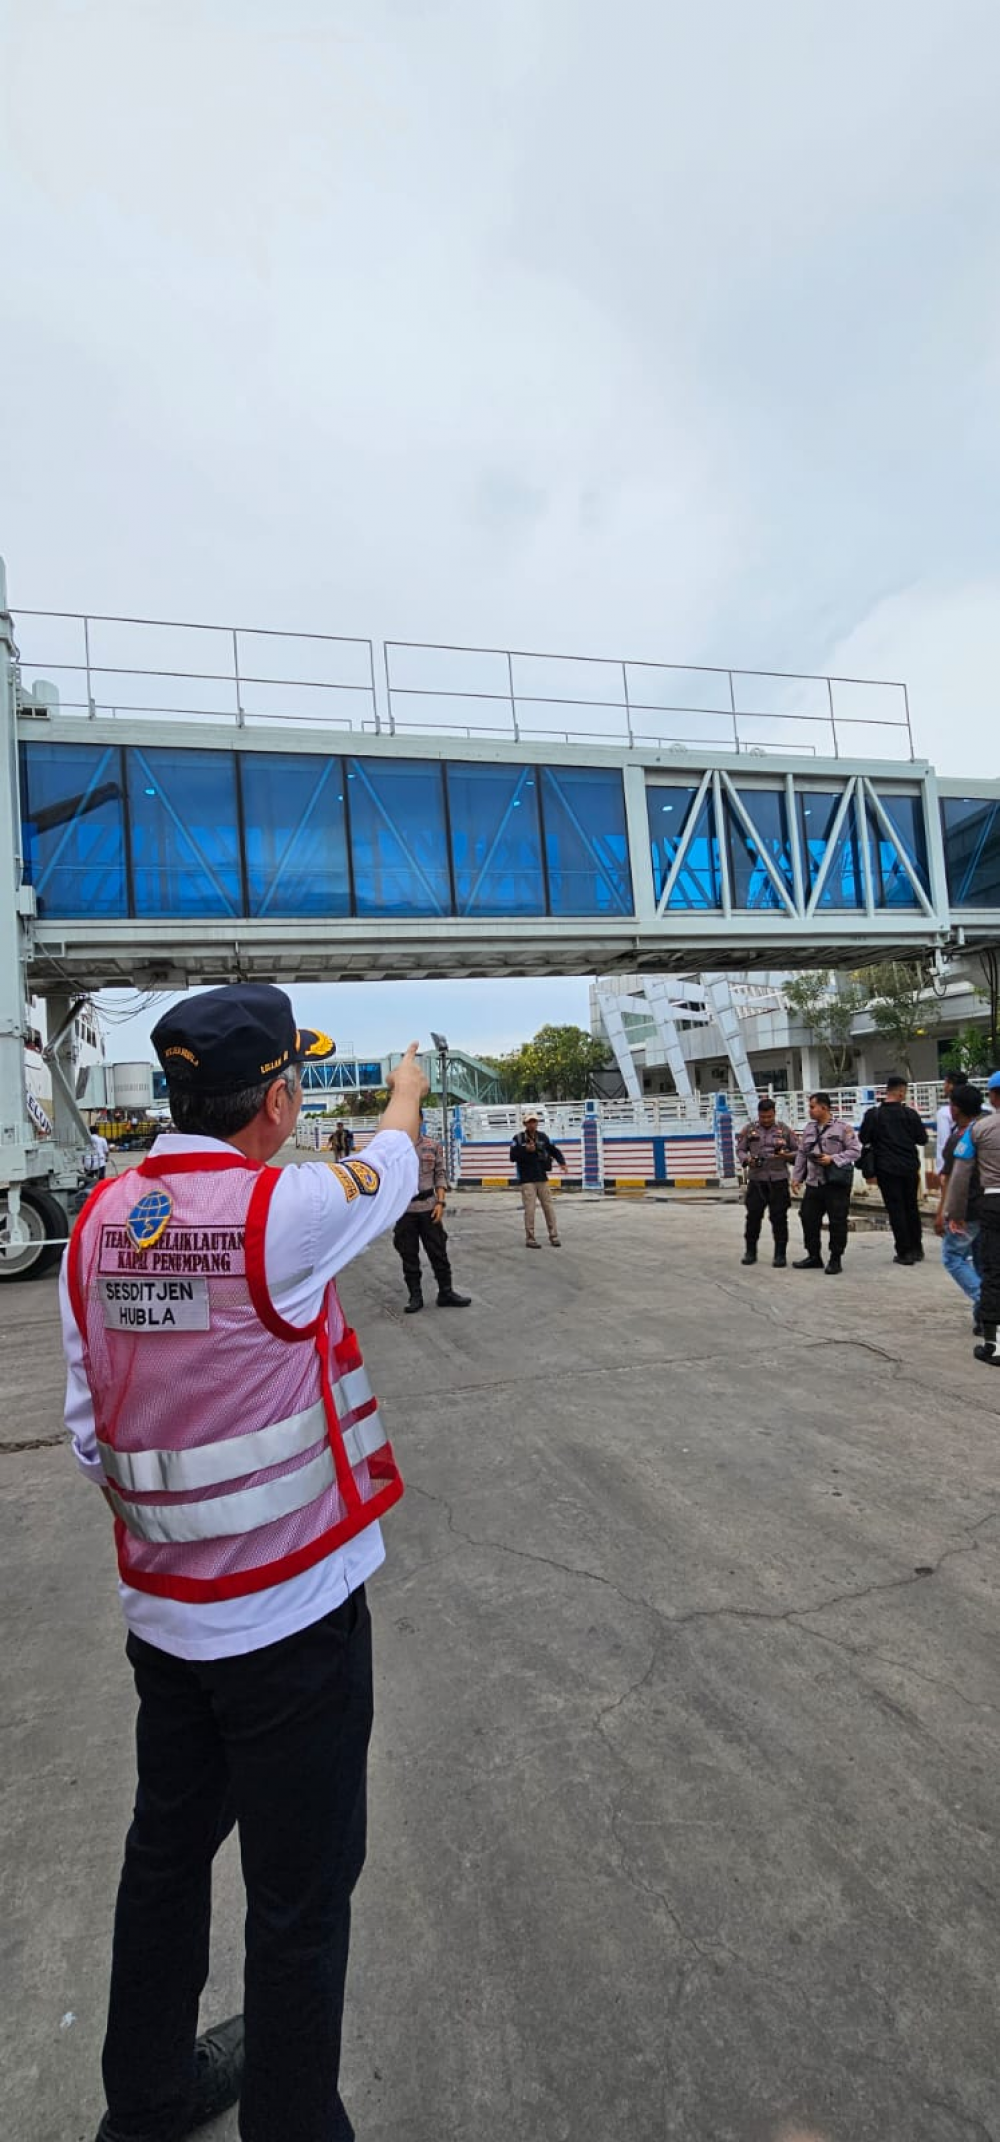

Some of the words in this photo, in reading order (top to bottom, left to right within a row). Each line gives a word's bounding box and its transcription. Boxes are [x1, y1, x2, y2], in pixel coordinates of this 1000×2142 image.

[152, 1231, 246, 1251] ELAIKLAUTAN
[152, 1253, 231, 1272] PENUMPANG
[106, 1282, 193, 1301] SESDITJEN
[119, 1307, 176, 1325] HUBLA
